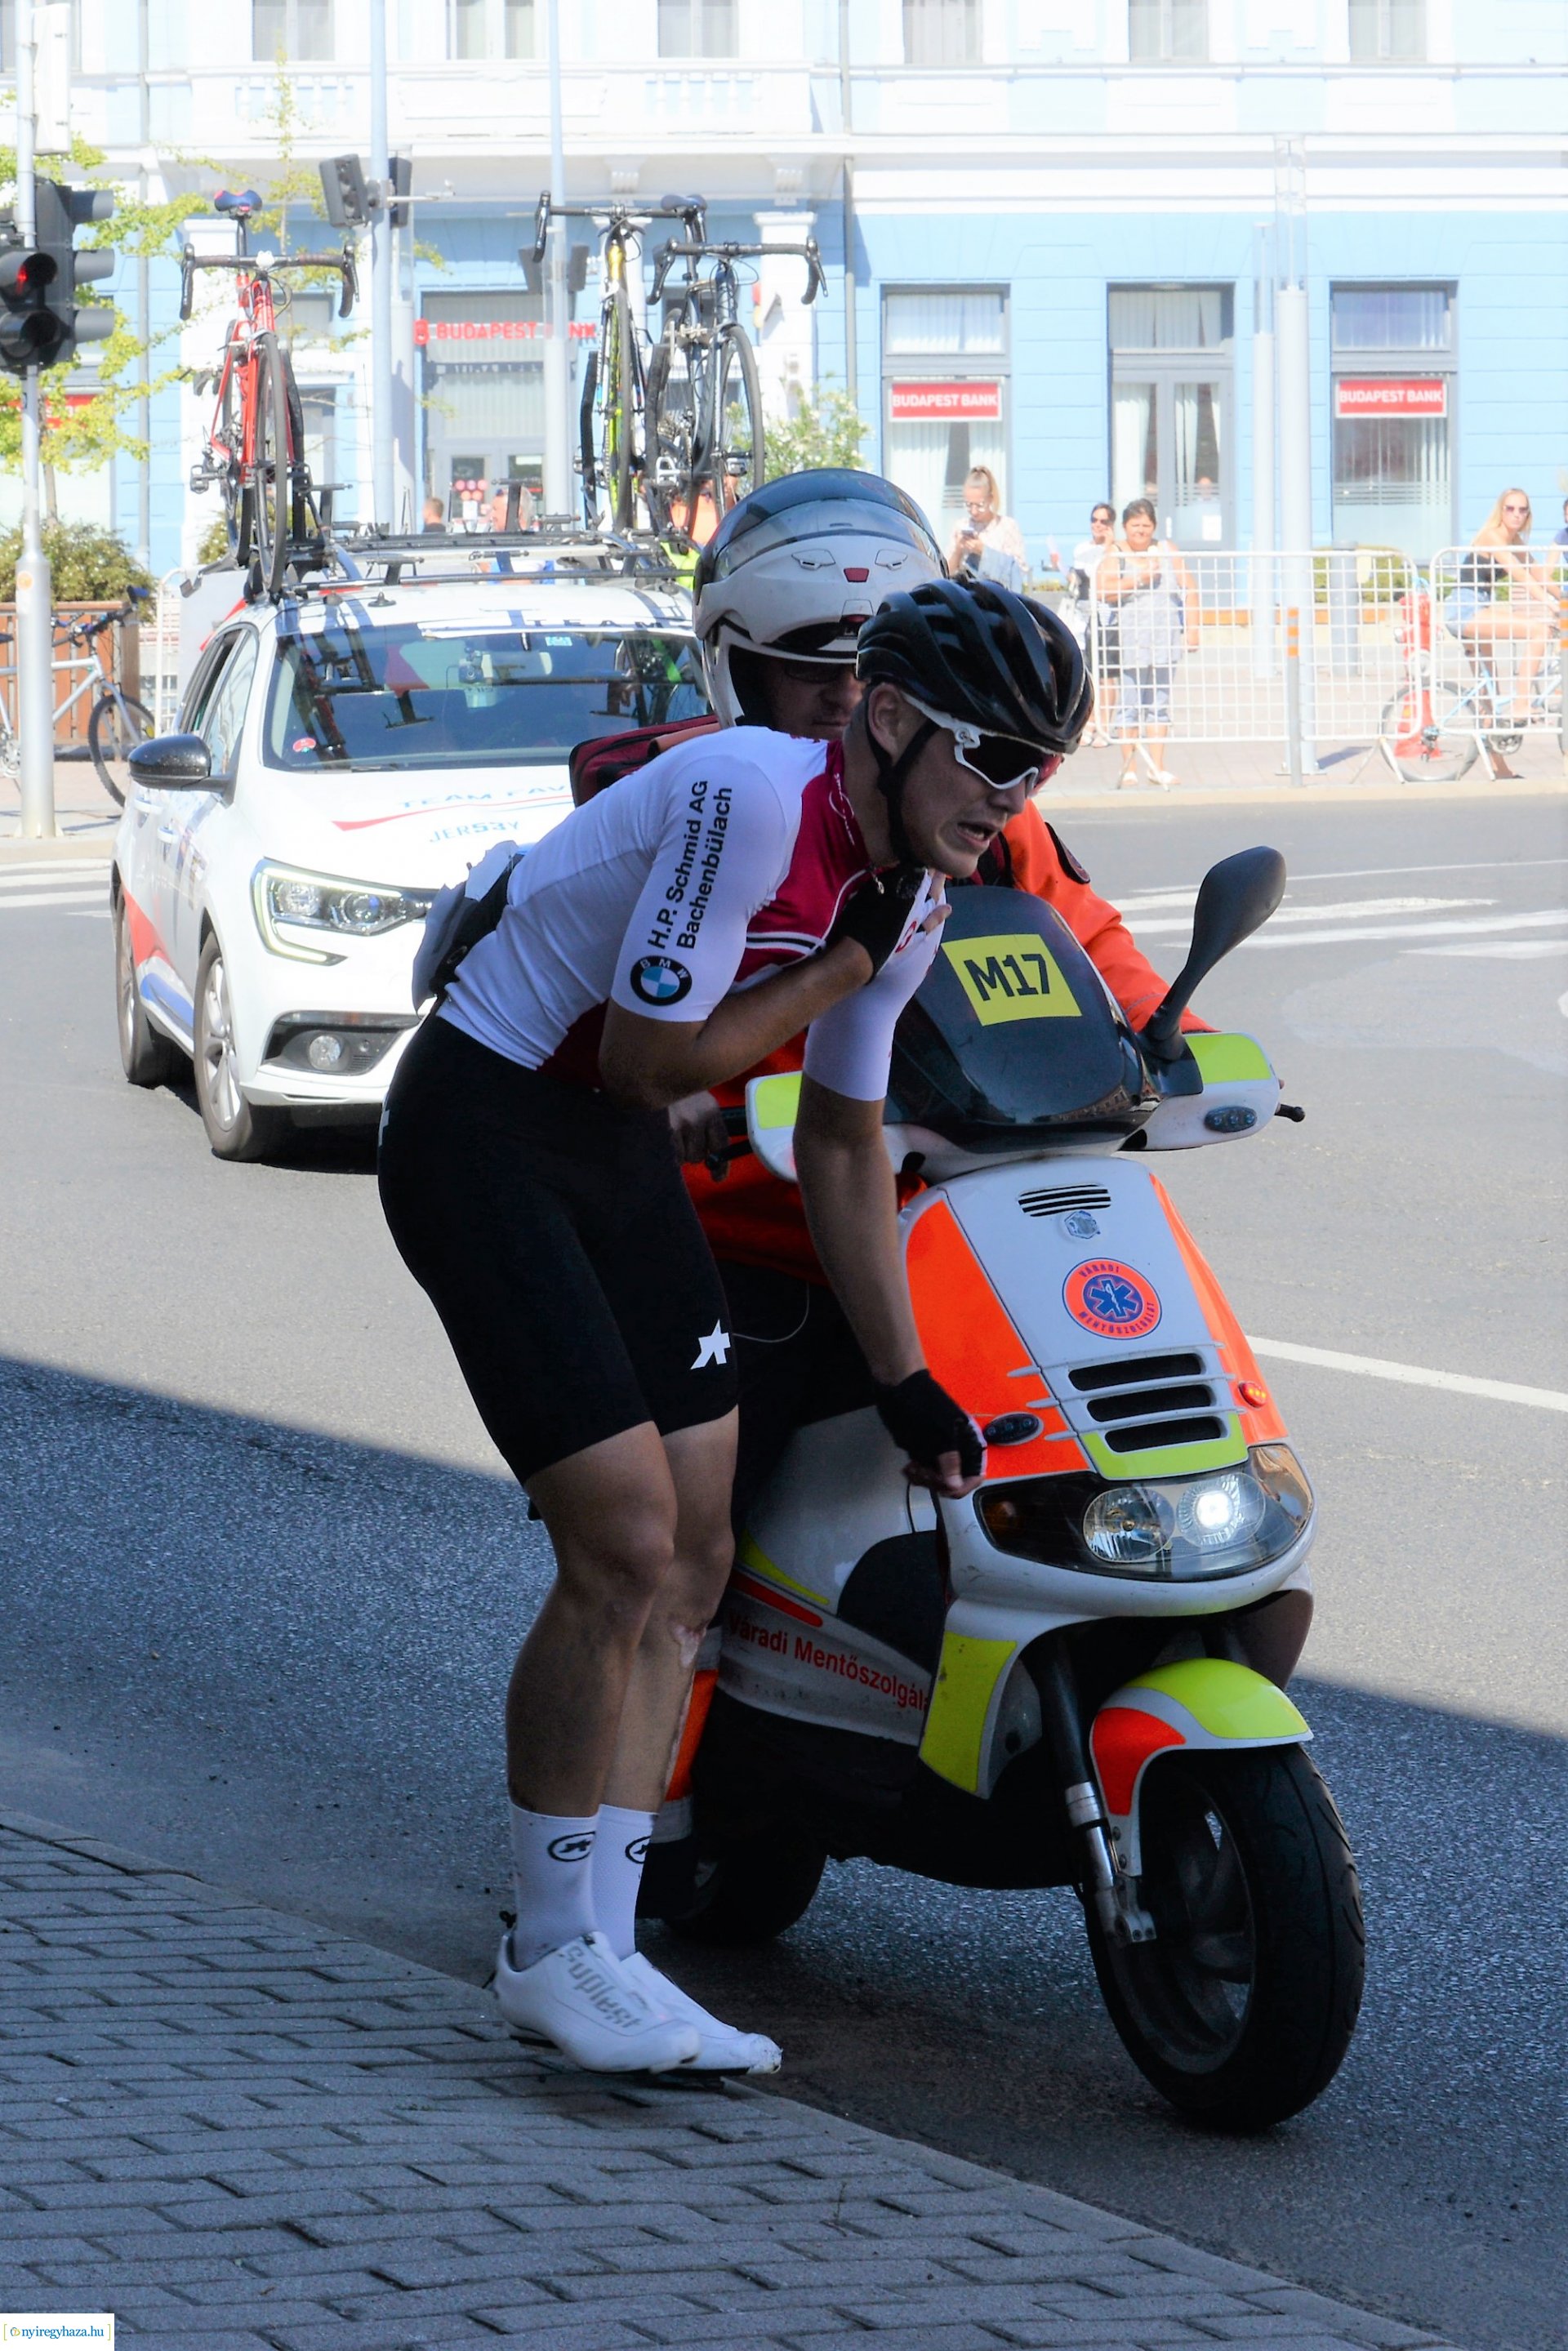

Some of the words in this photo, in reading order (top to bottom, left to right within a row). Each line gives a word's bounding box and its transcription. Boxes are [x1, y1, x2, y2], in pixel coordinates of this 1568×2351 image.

[435, 321, 537, 340] BUDAPEST
[892, 393, 960, 407] BUDAPEST
[960, 393, 998, 407] BANK
[1339, 390, 1405, 403] BUDAPEST
[1406, 390, 1443, 403] BANK
[398, 791, 492, 809] TEAM
[504, 785, 565, 797] FAV
[648, 907, 677, 949] H.P.
[666, 818, 702, 903] Schmid
[689, 780, 708, 814] AG
[676, 787, 733, 949] Bachenbülach
[639, 957, 690, 980] BMW
[963, 953, 1051, 1001] M17
[729, 1609, 788, 1654] Váradi
[793, 1636, 929, 1712] Mentőszolgála
